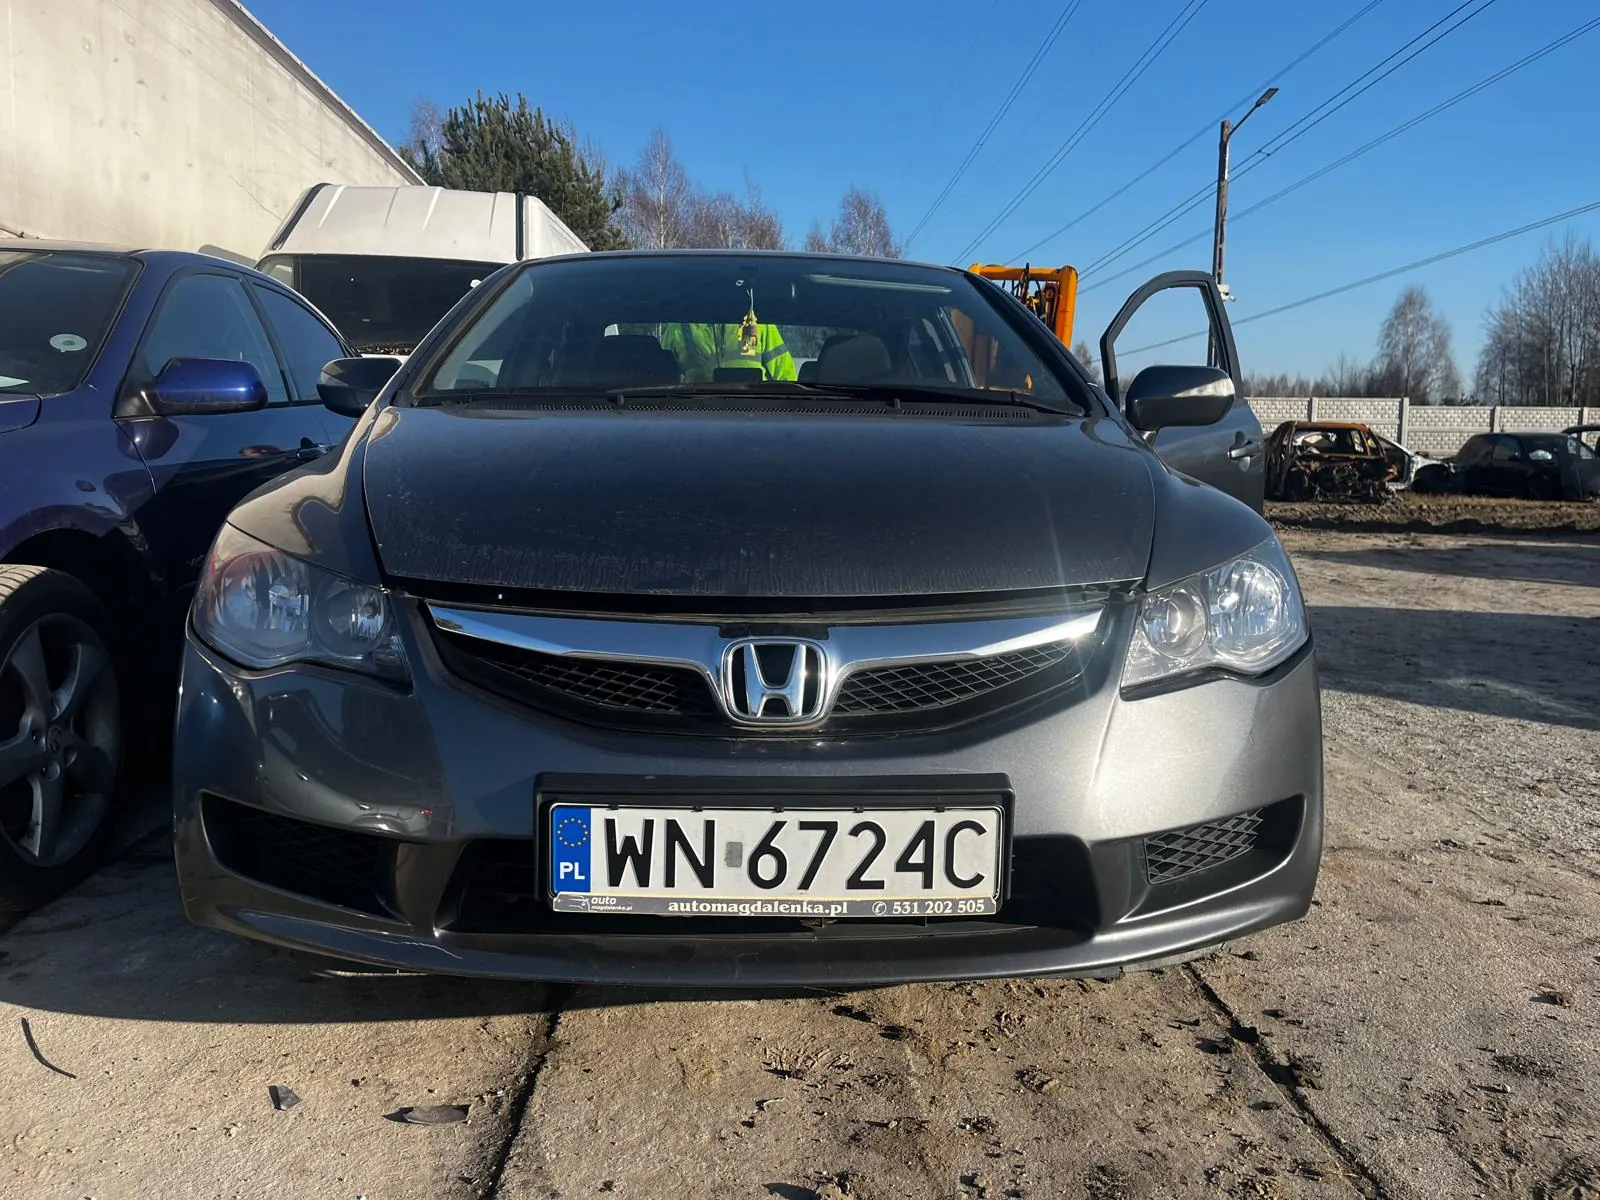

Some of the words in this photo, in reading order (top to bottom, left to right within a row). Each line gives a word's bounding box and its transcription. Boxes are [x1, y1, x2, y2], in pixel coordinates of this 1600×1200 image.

[604, 817, 717, 889] WN
[746, 819, 988, 891] 6724C
[559, 861, 586, 880] PL
[591, 896, 617, 905] auto
[667, 899, 848, 916] automagdalenka.pl
[892, 900, 923, 914] 531
[924, 900, 953, 914] 202
[957, 899, 985, 913] 505
